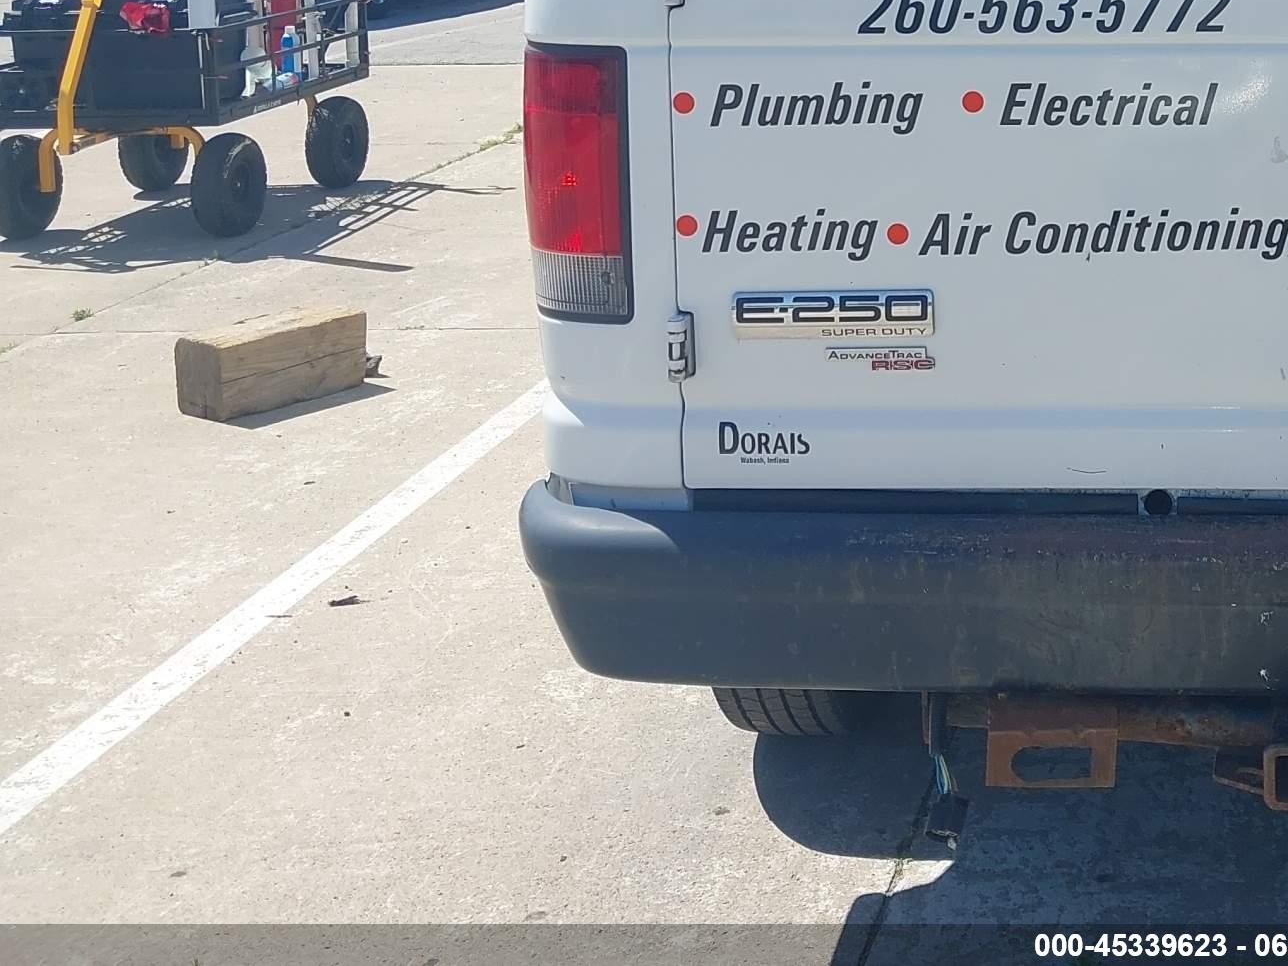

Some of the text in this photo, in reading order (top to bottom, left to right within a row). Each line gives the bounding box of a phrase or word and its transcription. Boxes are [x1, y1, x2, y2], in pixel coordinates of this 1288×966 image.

[710, 81, 1219, 134] Plumbing Electrical
[701, 208, 879, 261] Heating
[919, 212, 991, 256] Air
[735, 294, 929, 324] E-250
[821, 327, 927, 337] SUPER DUTY
[719, 421, 811, 455] DORAIS
